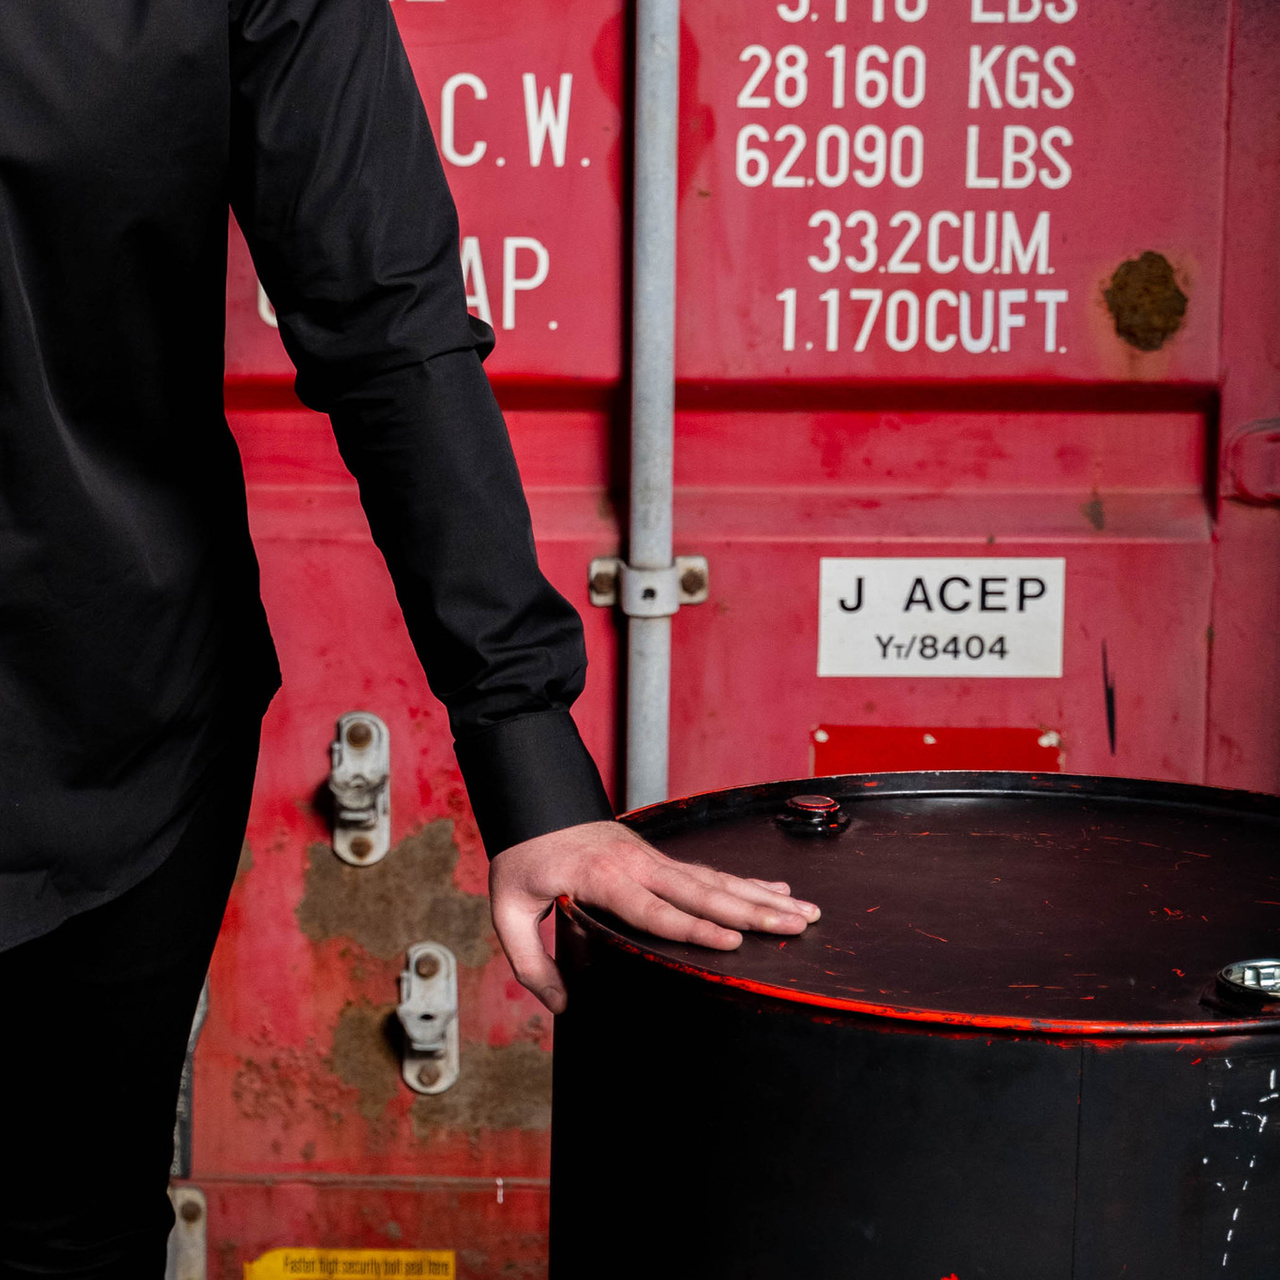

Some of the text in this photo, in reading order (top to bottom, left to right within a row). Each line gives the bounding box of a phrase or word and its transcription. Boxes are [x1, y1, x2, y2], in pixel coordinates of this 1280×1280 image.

[968, 45, 1076, 109] KGS
[441, 72, 590, 168] C.W.
[735, 123, 1073, 189] 62.090 LBS
[839, 576, 1046, 613] J ACEP
